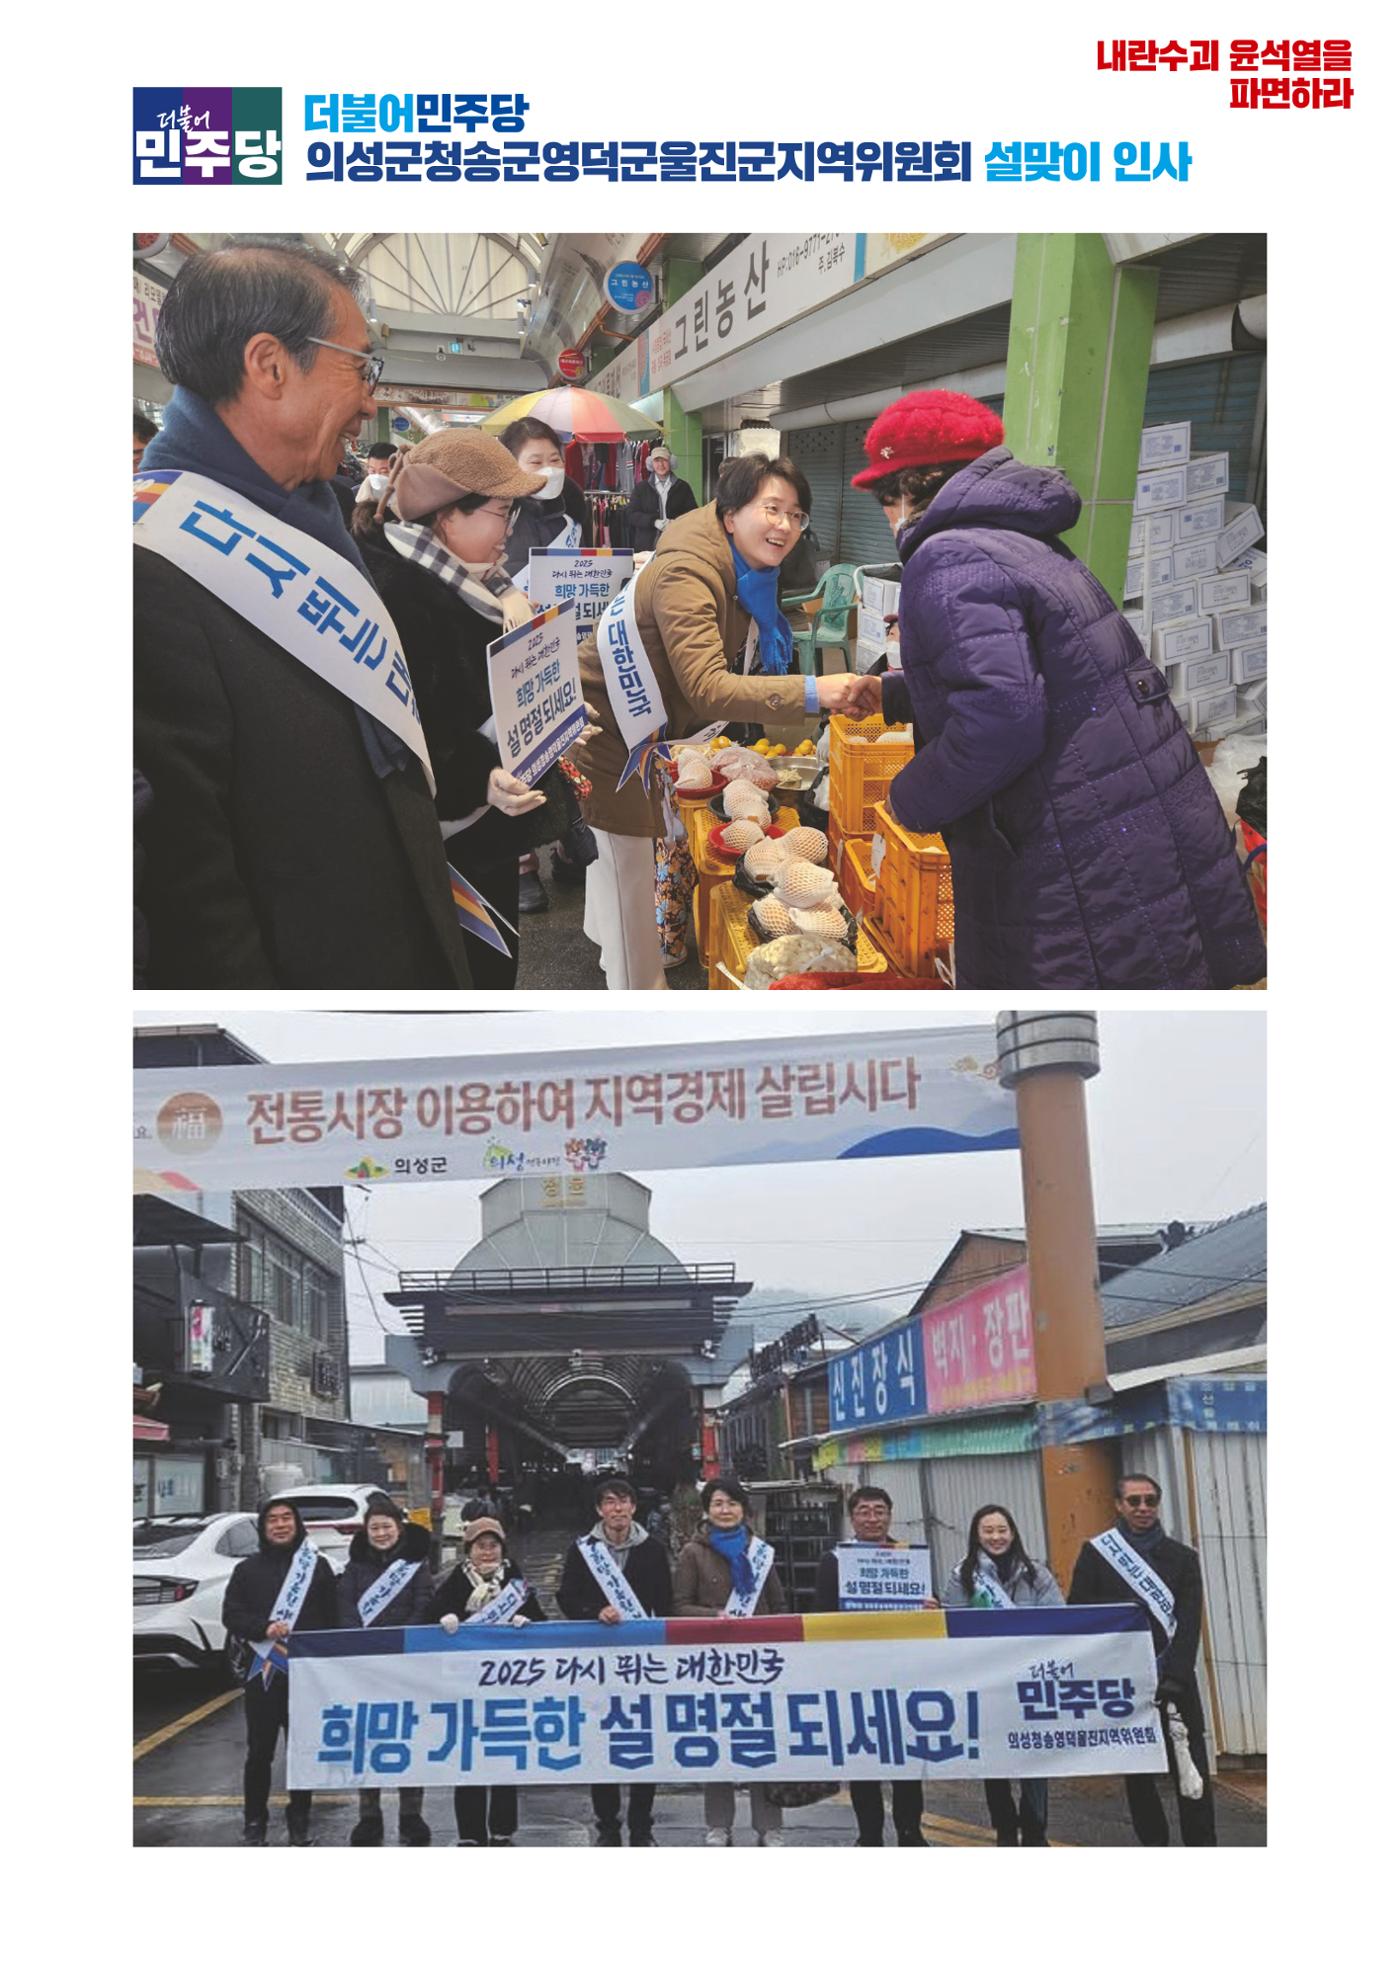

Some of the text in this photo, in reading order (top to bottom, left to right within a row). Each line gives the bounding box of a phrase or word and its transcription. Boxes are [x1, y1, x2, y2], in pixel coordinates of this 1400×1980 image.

[674, 240, 770, 360] 그린농산
[179, 500, 388, 671] 다시 뛰는
[555, 583, 610, 599] 희망 가득한
[516, 658, 561, 708] 희망 가득한
[607, 618, 652, 718] 대한민국
[507, 677, 577, 759] 설 명절 되세요!
[246, 1056, 923, 1145] 전통시장 이용하여 지역경제 살립시다
[394, 1156, 448, 1175] 의성군
[831, 1328, 916, 1420] 신진장식
[479, 1647, 786, 1687] 2025 다시 뛰는 대한민국
[1016, 1678, 1136, 1721] 민주당
[1030, 1660, 1075, 1681] 더불어
[318, 1688, 980, 1775] 희망 가득한 설 명절 되세요!
[1008, 1726, 1158, 1750] 의성청송영덕울진지역위원회
